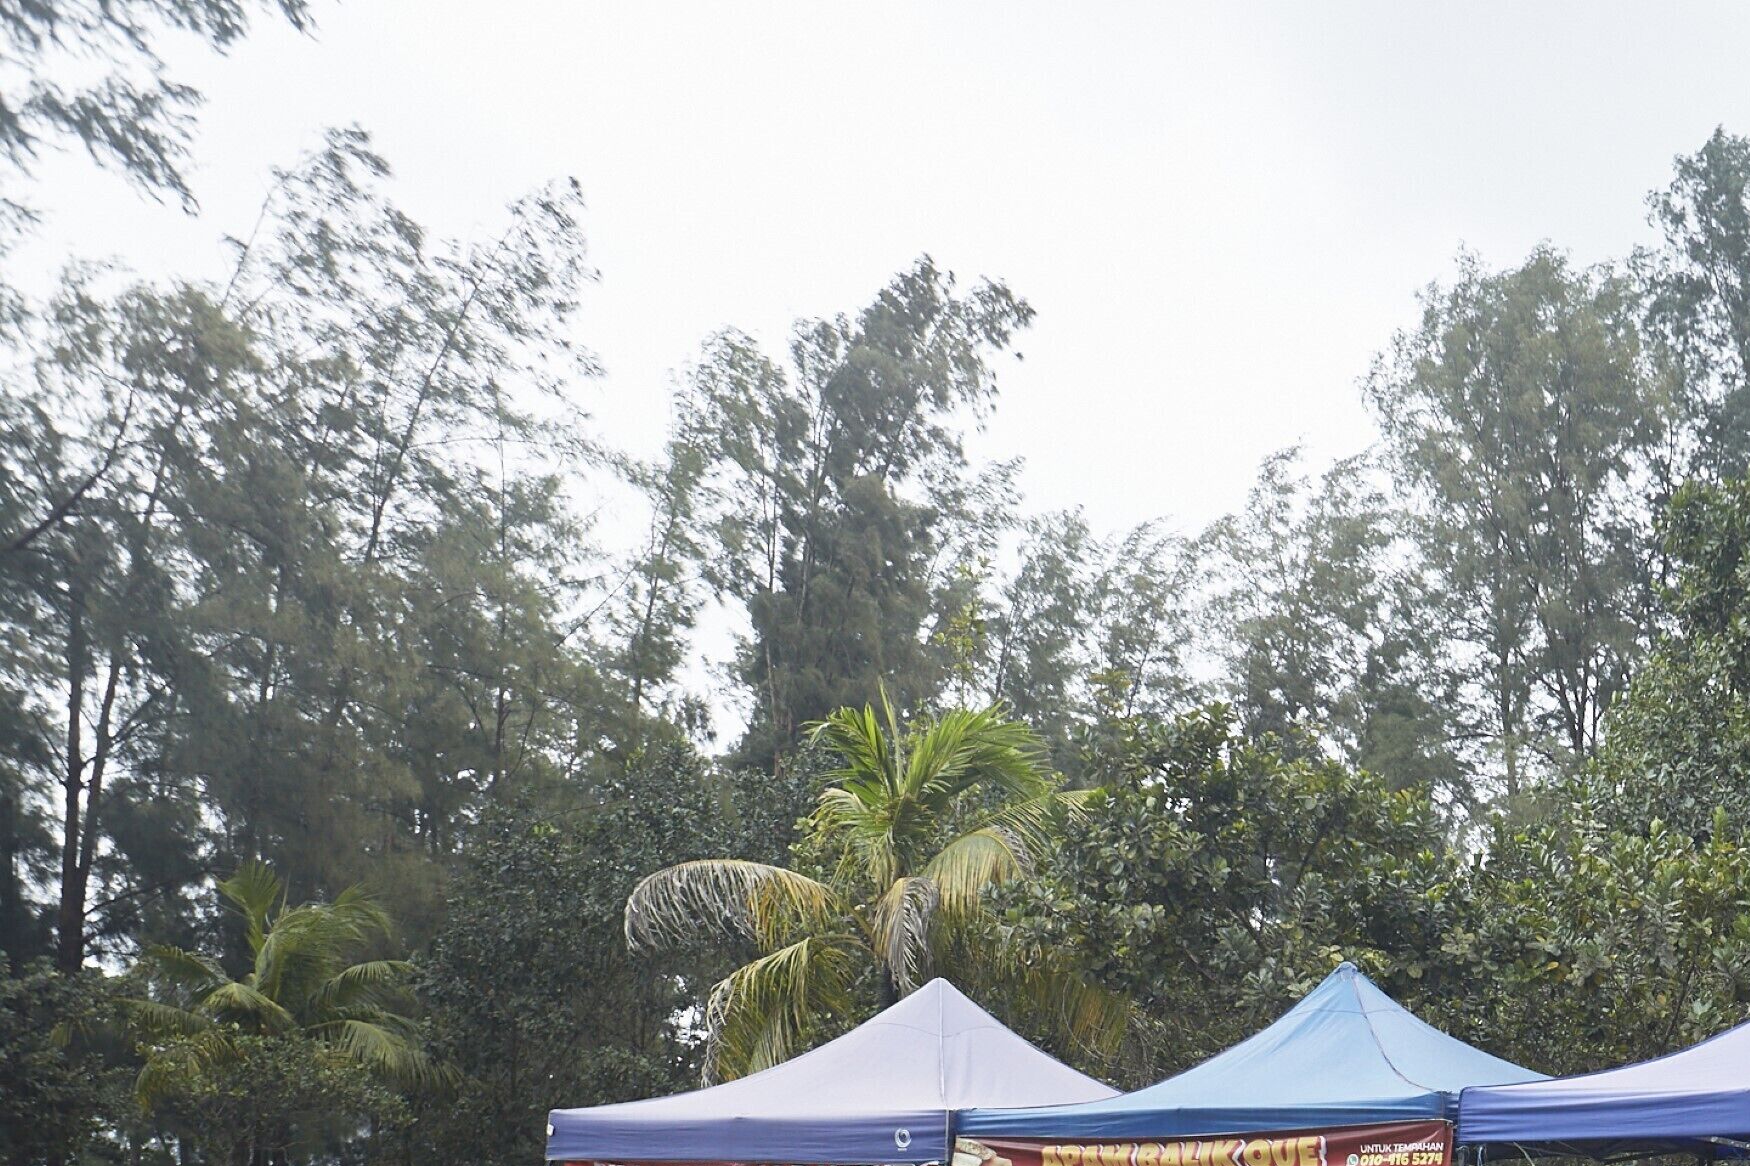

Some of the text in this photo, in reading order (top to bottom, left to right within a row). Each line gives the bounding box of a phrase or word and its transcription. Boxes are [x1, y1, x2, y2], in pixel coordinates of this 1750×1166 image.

[1360, 1142, 1444, 1154] UNTUK TEMPAHAN
[1360, 1152, 1443, 1166] 010-416 5274
